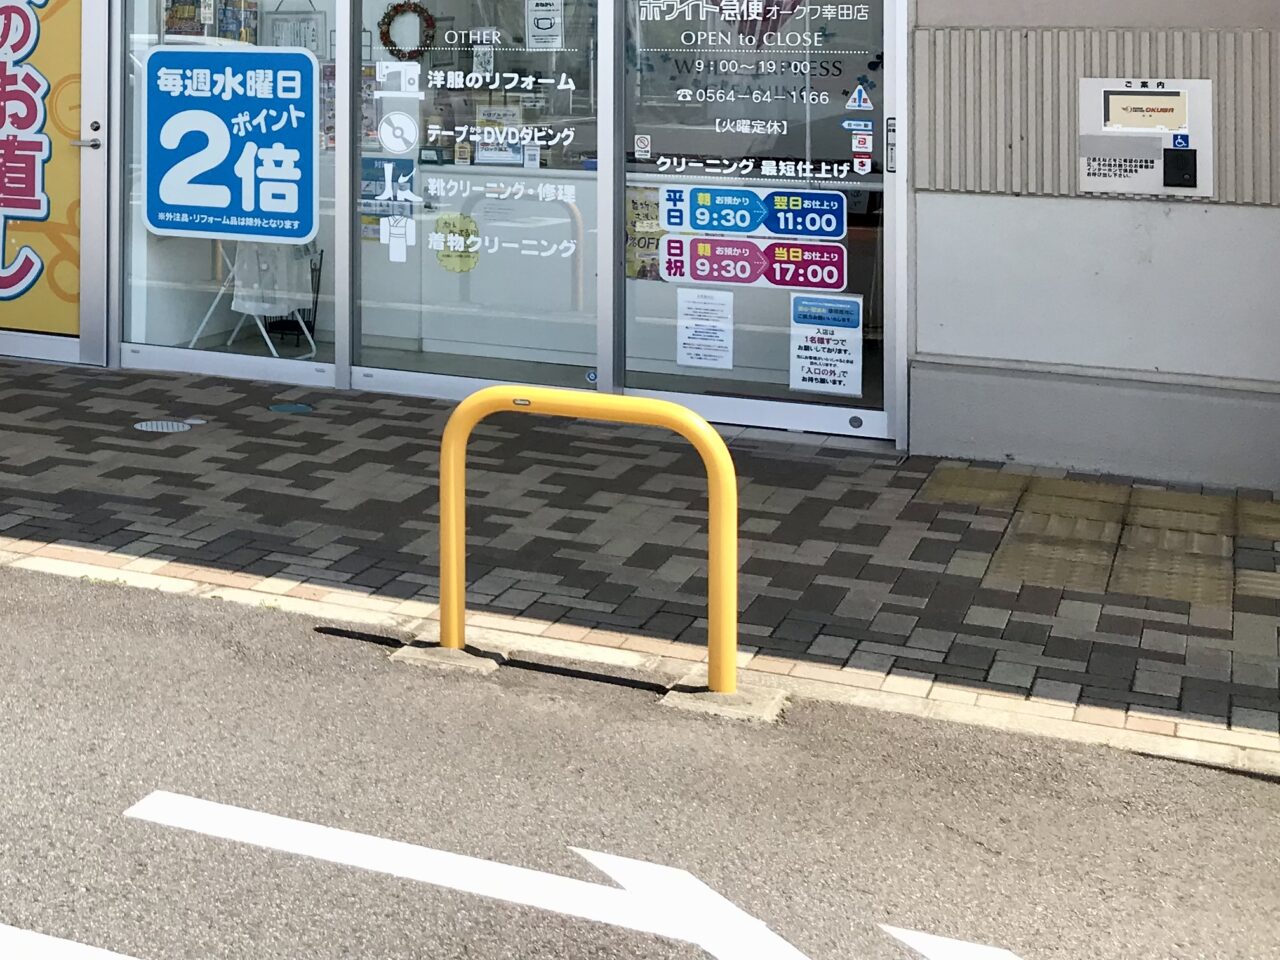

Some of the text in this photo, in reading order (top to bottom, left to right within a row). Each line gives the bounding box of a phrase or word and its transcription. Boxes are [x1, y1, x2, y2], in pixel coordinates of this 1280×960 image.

[766, 3, 869, 21] オークワ幸田店
[444, 30, 502, 45] OTHER
[681, 31, 823, 47] OPEN to CLOSE
[157, 67, 301, 101] 毎週水曜日
[427, 70, 576, 91] 洋服のリフォーム
[231, 104, 305, 137] ポイント
[656, 156, 850, 178] クリーニング 最短仕上げ
[427, 177, 577, 202] 靴クリーニング・修理
[666, 190, 684, 226] 平日
[716, 196, 750, 206] お預かり
[695, 208, 751, 228] 9:30
[777, 212, 837, 232] 11:00
[427, 232, 577, 258] 着物クリーニング
[716, 246, 750, 257] お預かり
[666, 240, 685, 277] 日祝
[695, 258, 751, 279] 9:30
[772, 263, 839, 284] 17:00
[816, 328, 835, 336] 入店は
